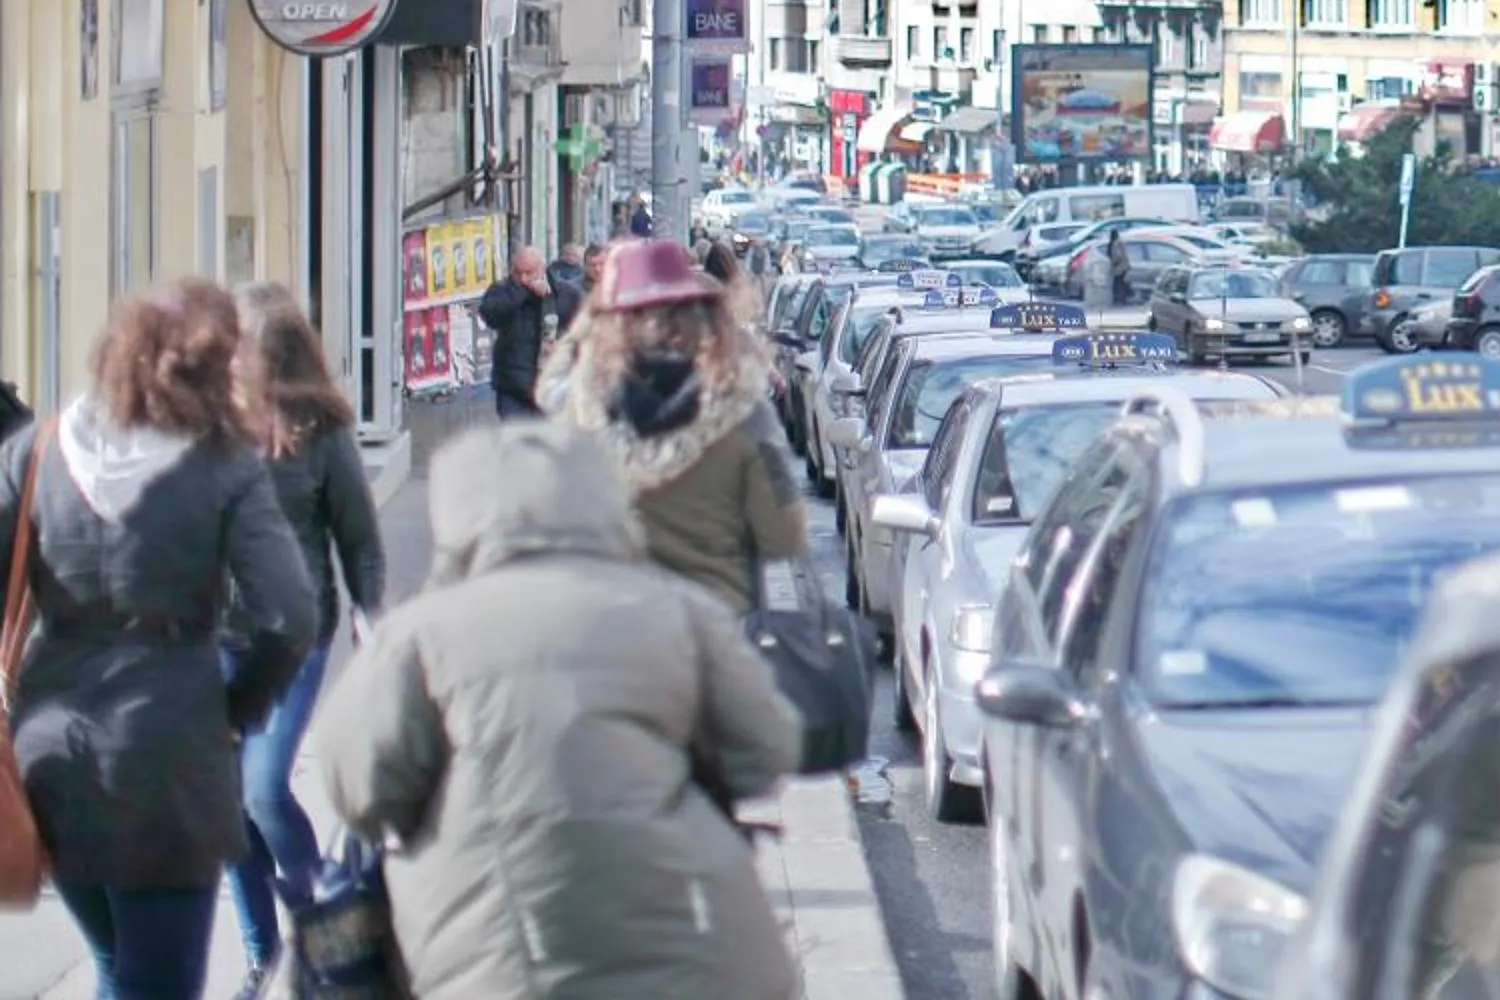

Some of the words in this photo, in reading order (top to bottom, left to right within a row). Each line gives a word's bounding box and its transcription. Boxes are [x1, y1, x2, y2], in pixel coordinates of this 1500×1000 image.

[281, 1, 348, 21] OPEN
[695, 12, 737, 32] BANE
[1140, 347, 1172, 357] TAXI
